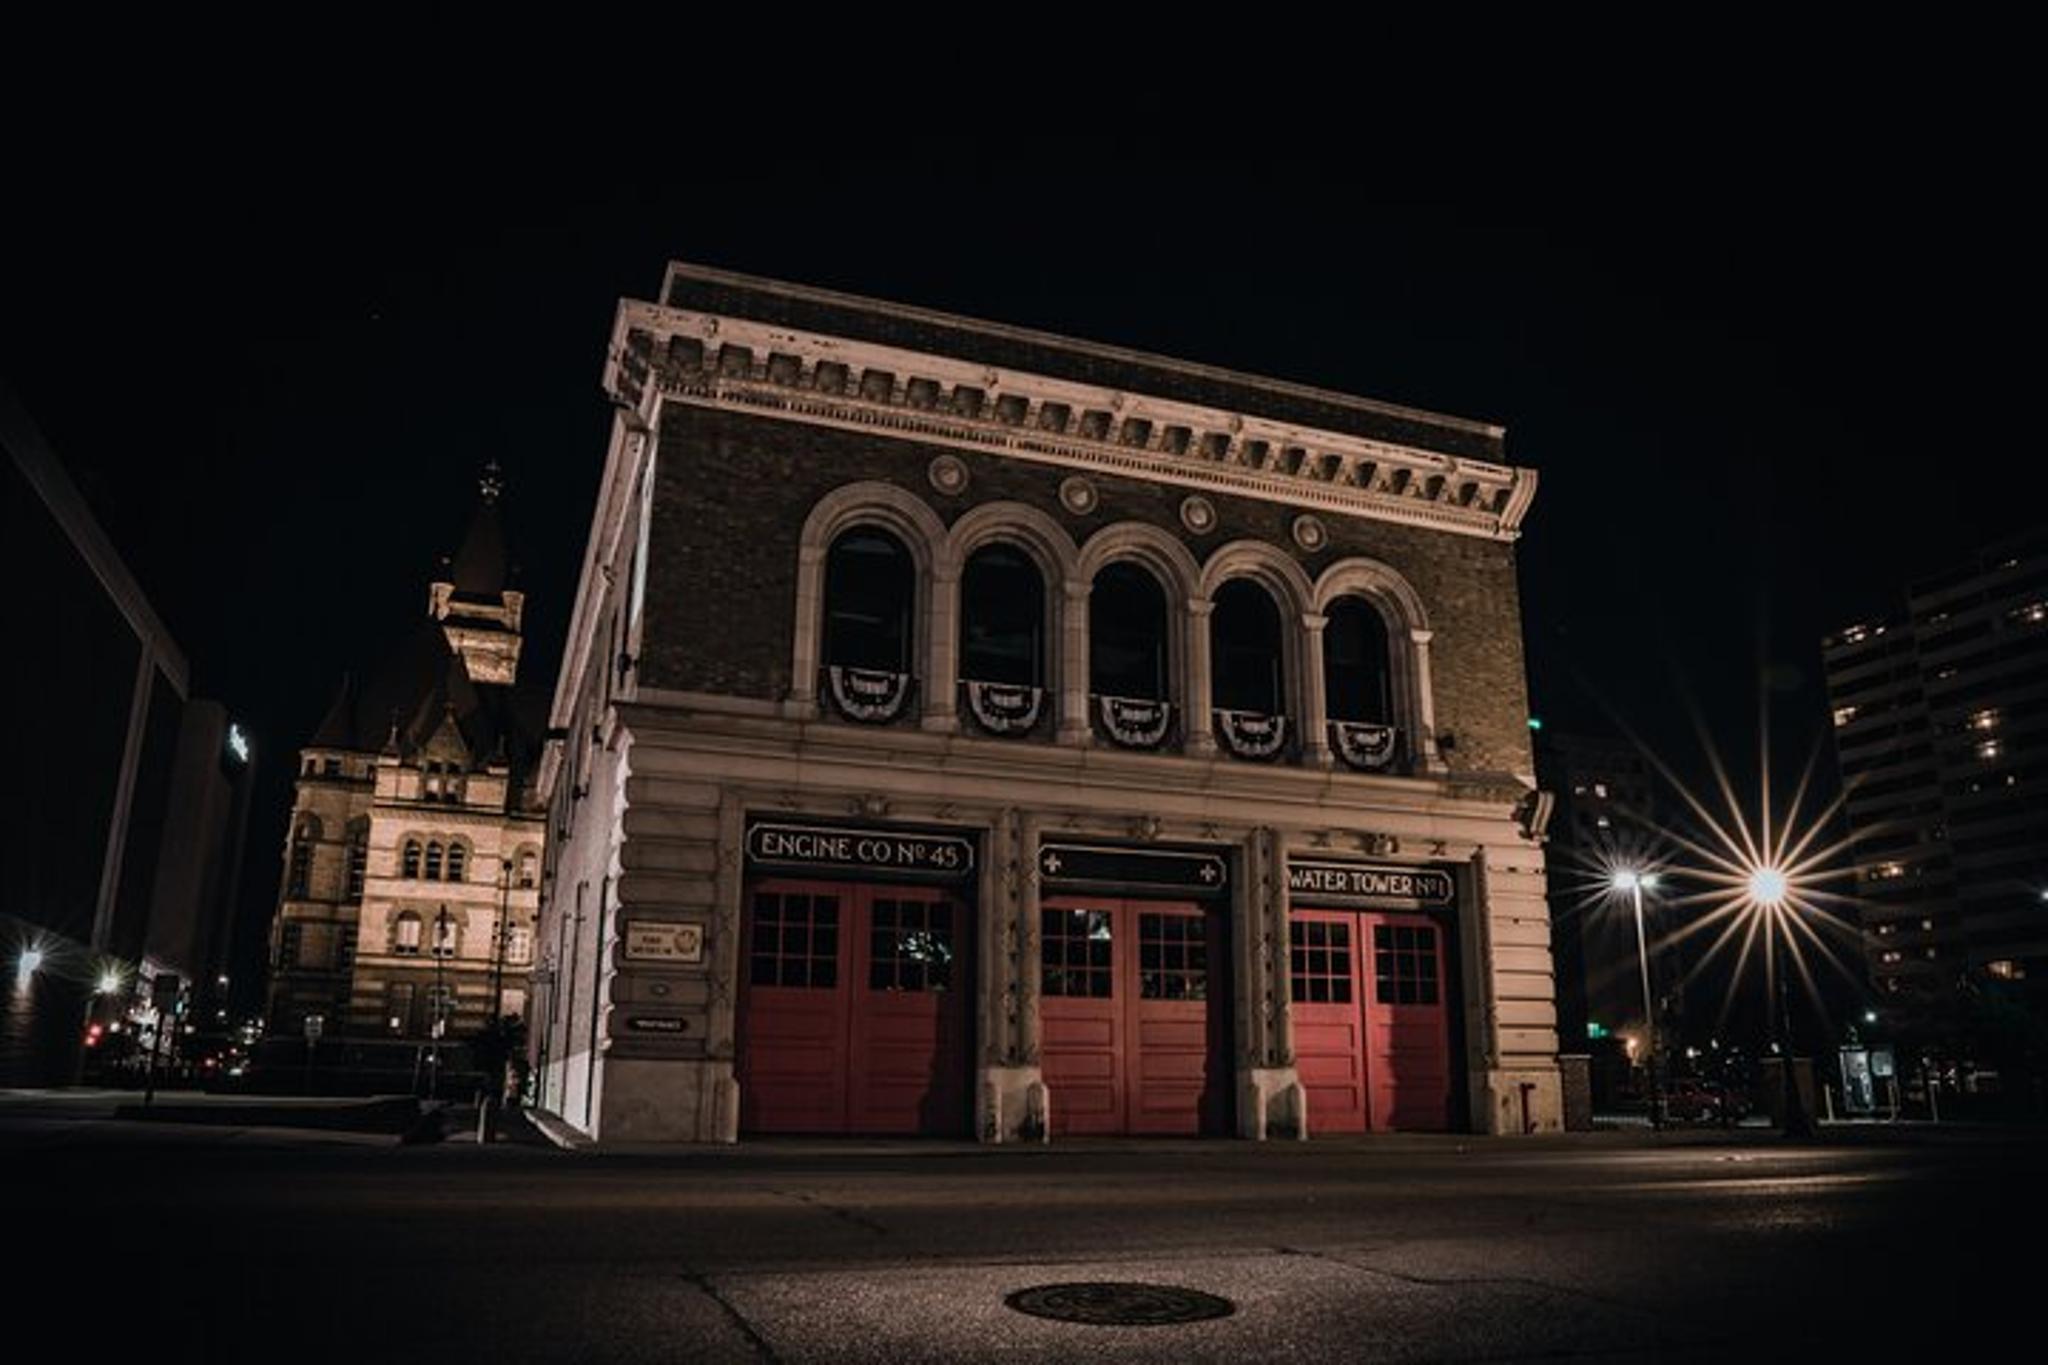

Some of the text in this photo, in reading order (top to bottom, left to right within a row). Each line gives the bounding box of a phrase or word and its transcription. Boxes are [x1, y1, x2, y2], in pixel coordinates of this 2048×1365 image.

[761, 832, 851, 860] ENGINE
[858, 839, 892, 862] CO
[930, 846, 959, 867] 45
[1290, 869, 1347, 891] WATER
[1351, 872, 1412, 895] TOWER
